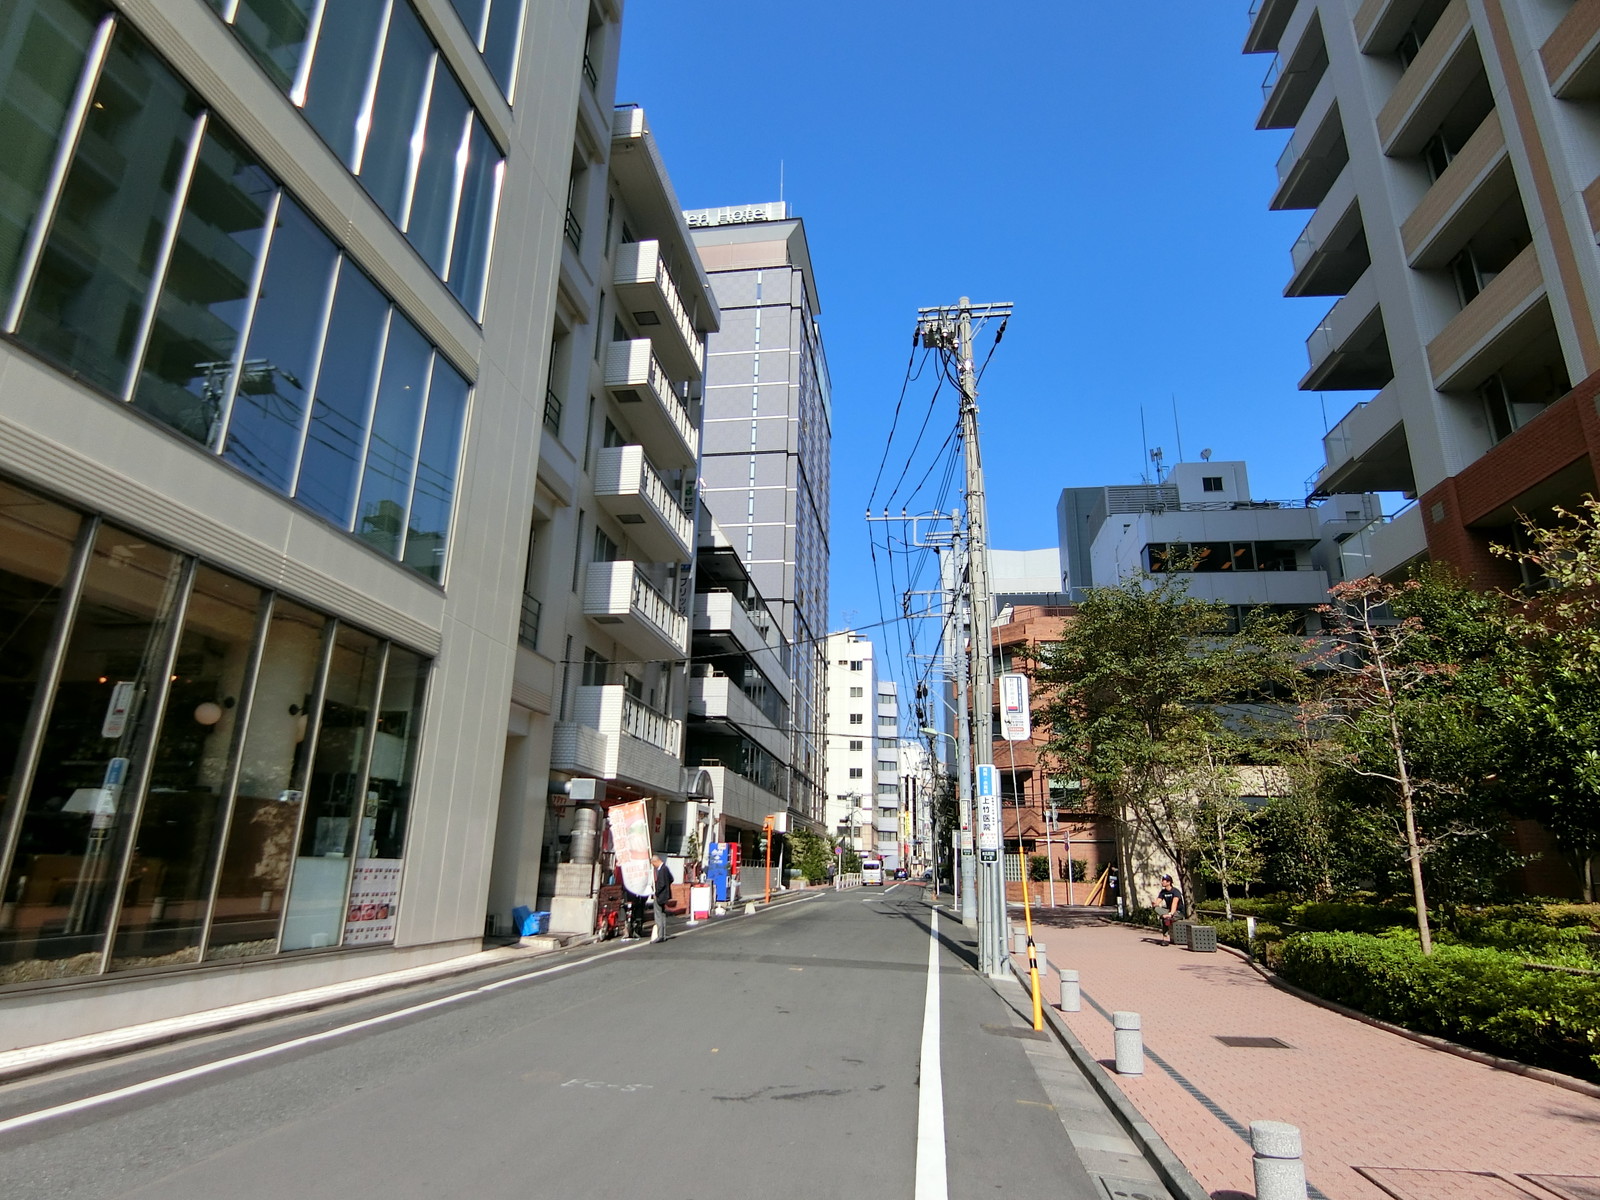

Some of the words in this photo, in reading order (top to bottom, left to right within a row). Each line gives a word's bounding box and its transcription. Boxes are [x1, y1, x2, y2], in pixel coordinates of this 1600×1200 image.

[718, 203, 768, 224] Hotel
[982, 797, 991, 831] 上竹医院
